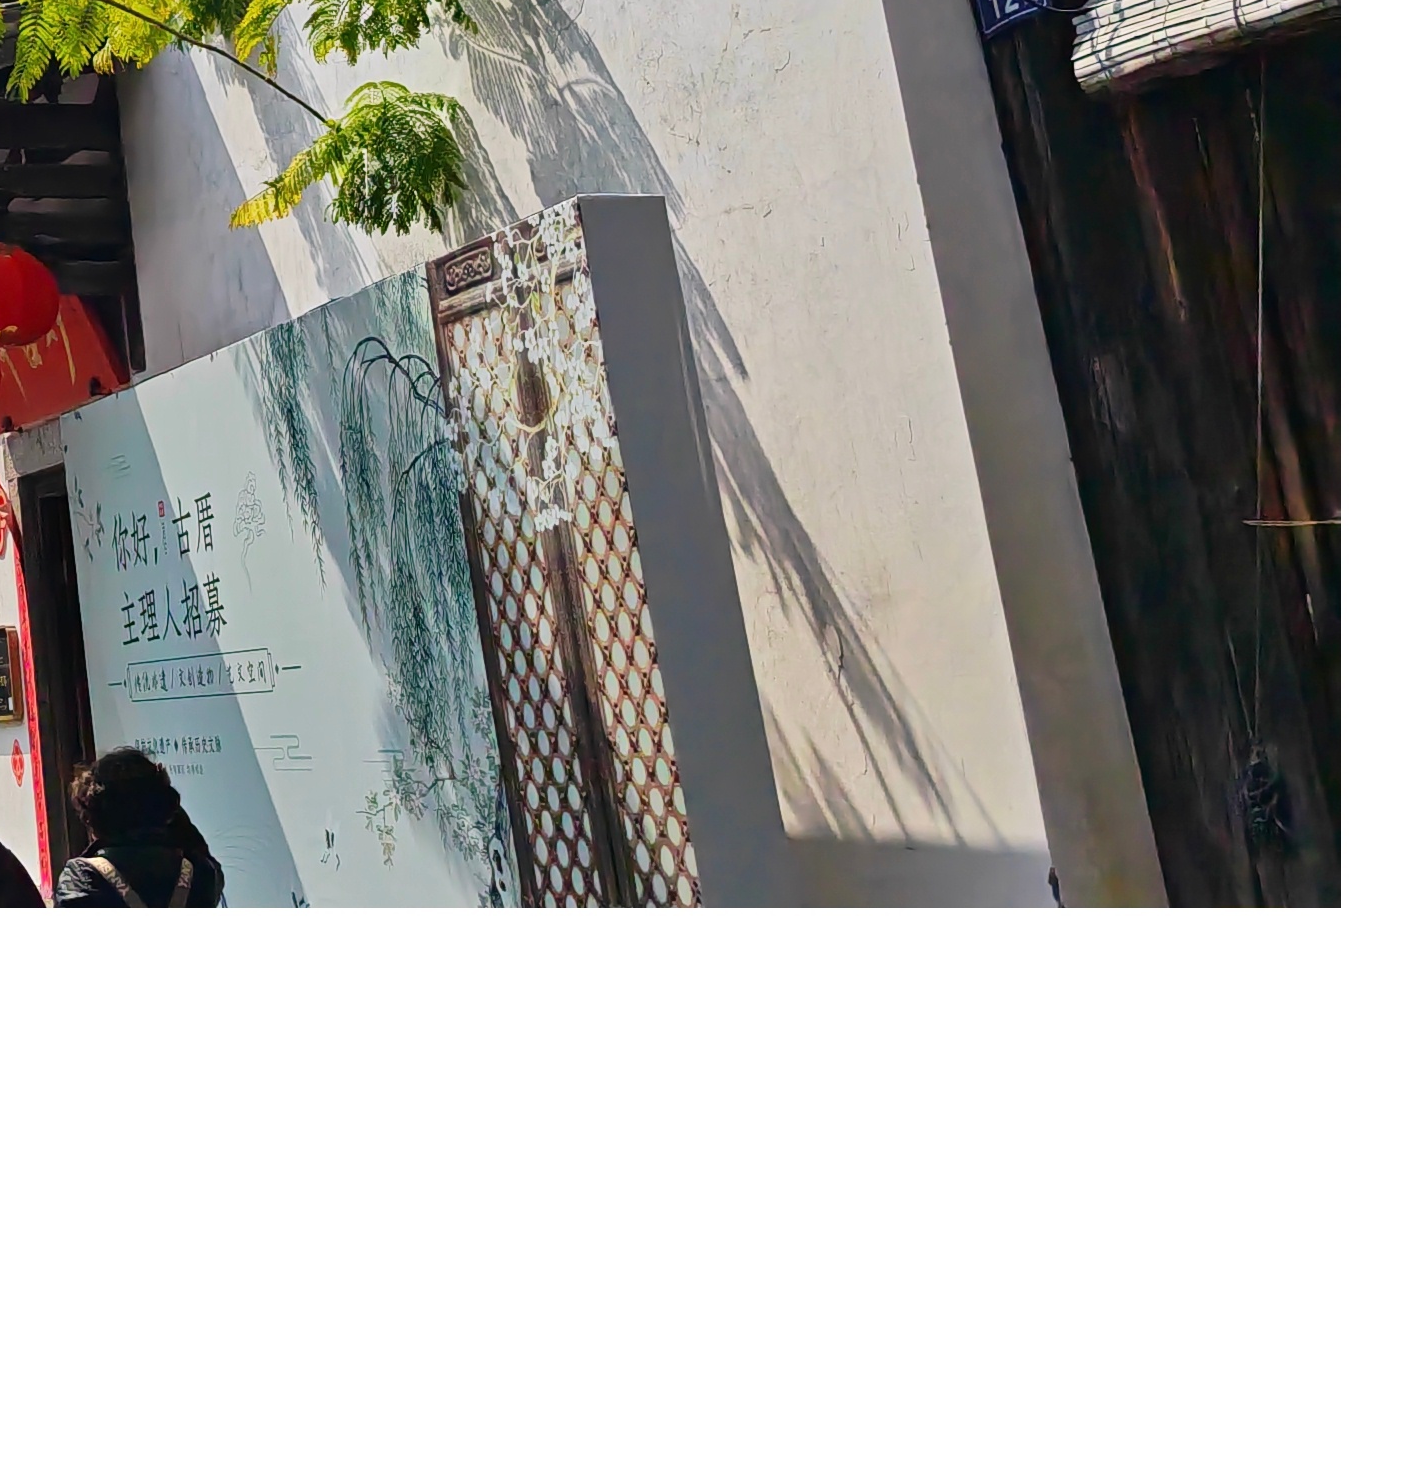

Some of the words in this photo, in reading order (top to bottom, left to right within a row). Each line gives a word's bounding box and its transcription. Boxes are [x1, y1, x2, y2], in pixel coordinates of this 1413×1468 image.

[121, 571, 228, 646] 主理人招募
